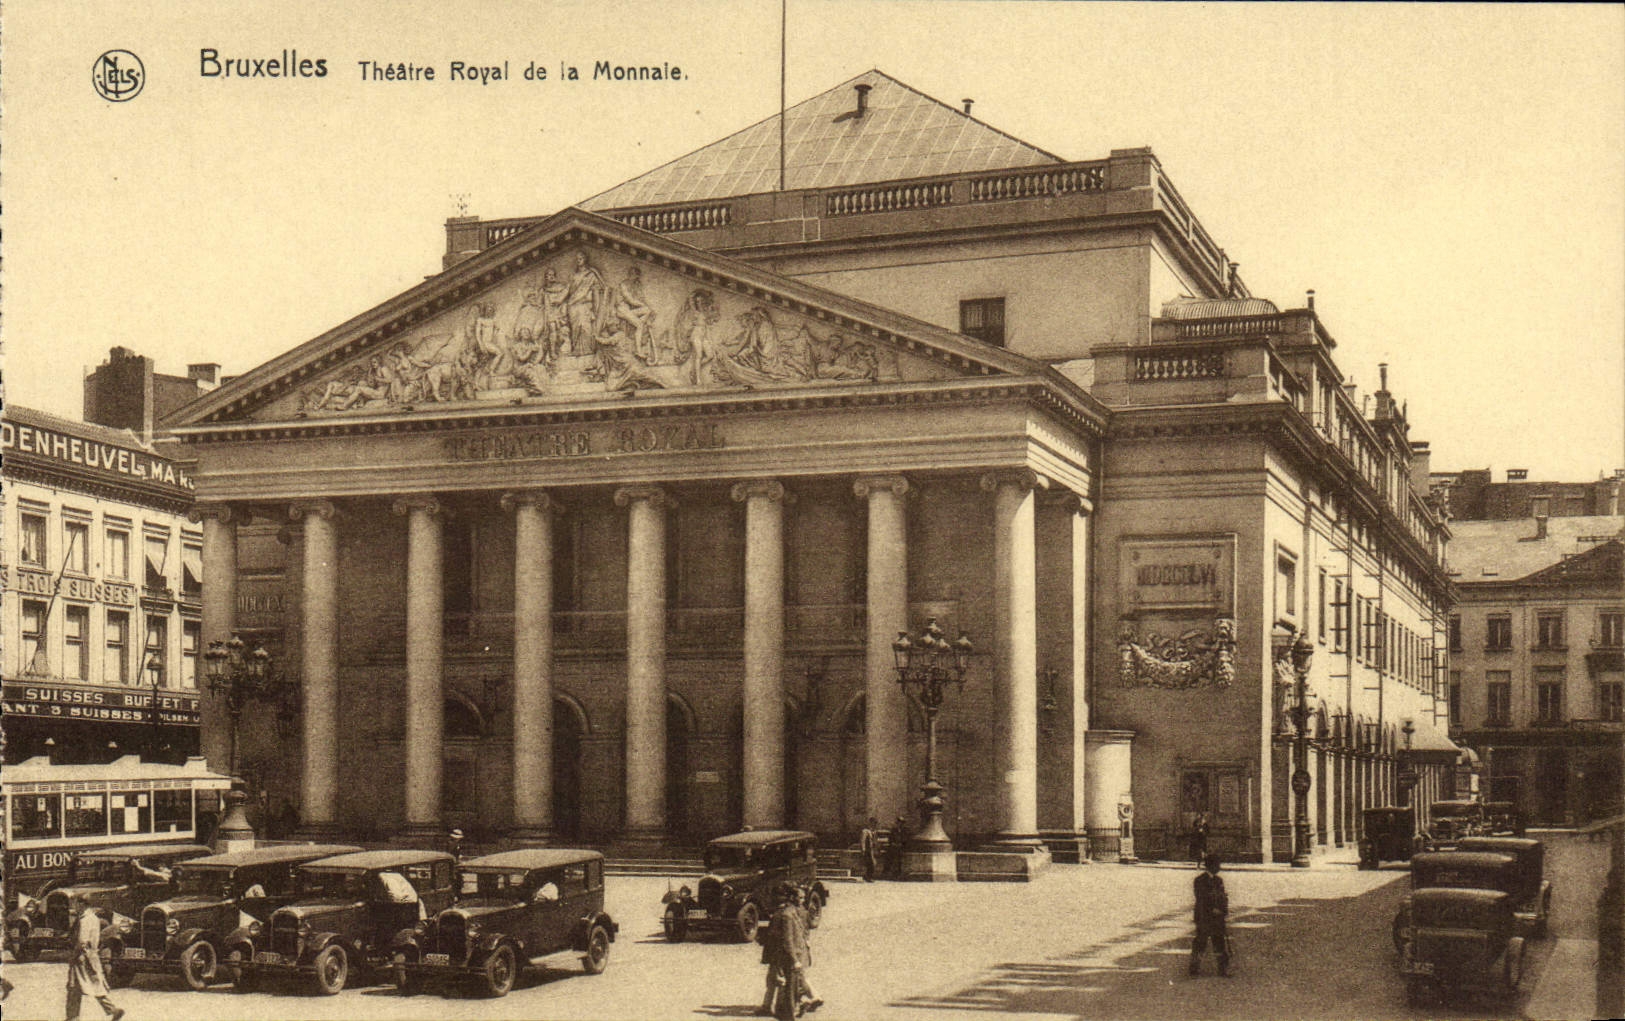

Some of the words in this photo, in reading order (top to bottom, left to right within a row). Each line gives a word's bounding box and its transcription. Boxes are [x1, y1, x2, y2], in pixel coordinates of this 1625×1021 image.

[612, 423, 727, 453] ROYAL
[70, 580, 129, 603] SUISSES
[26, 688, 104, 704] SUISSES
[51, 704, 61, 715] 3
[70, 707, 142, 721] SUISSES
[15, 854, 37, 870] AU
